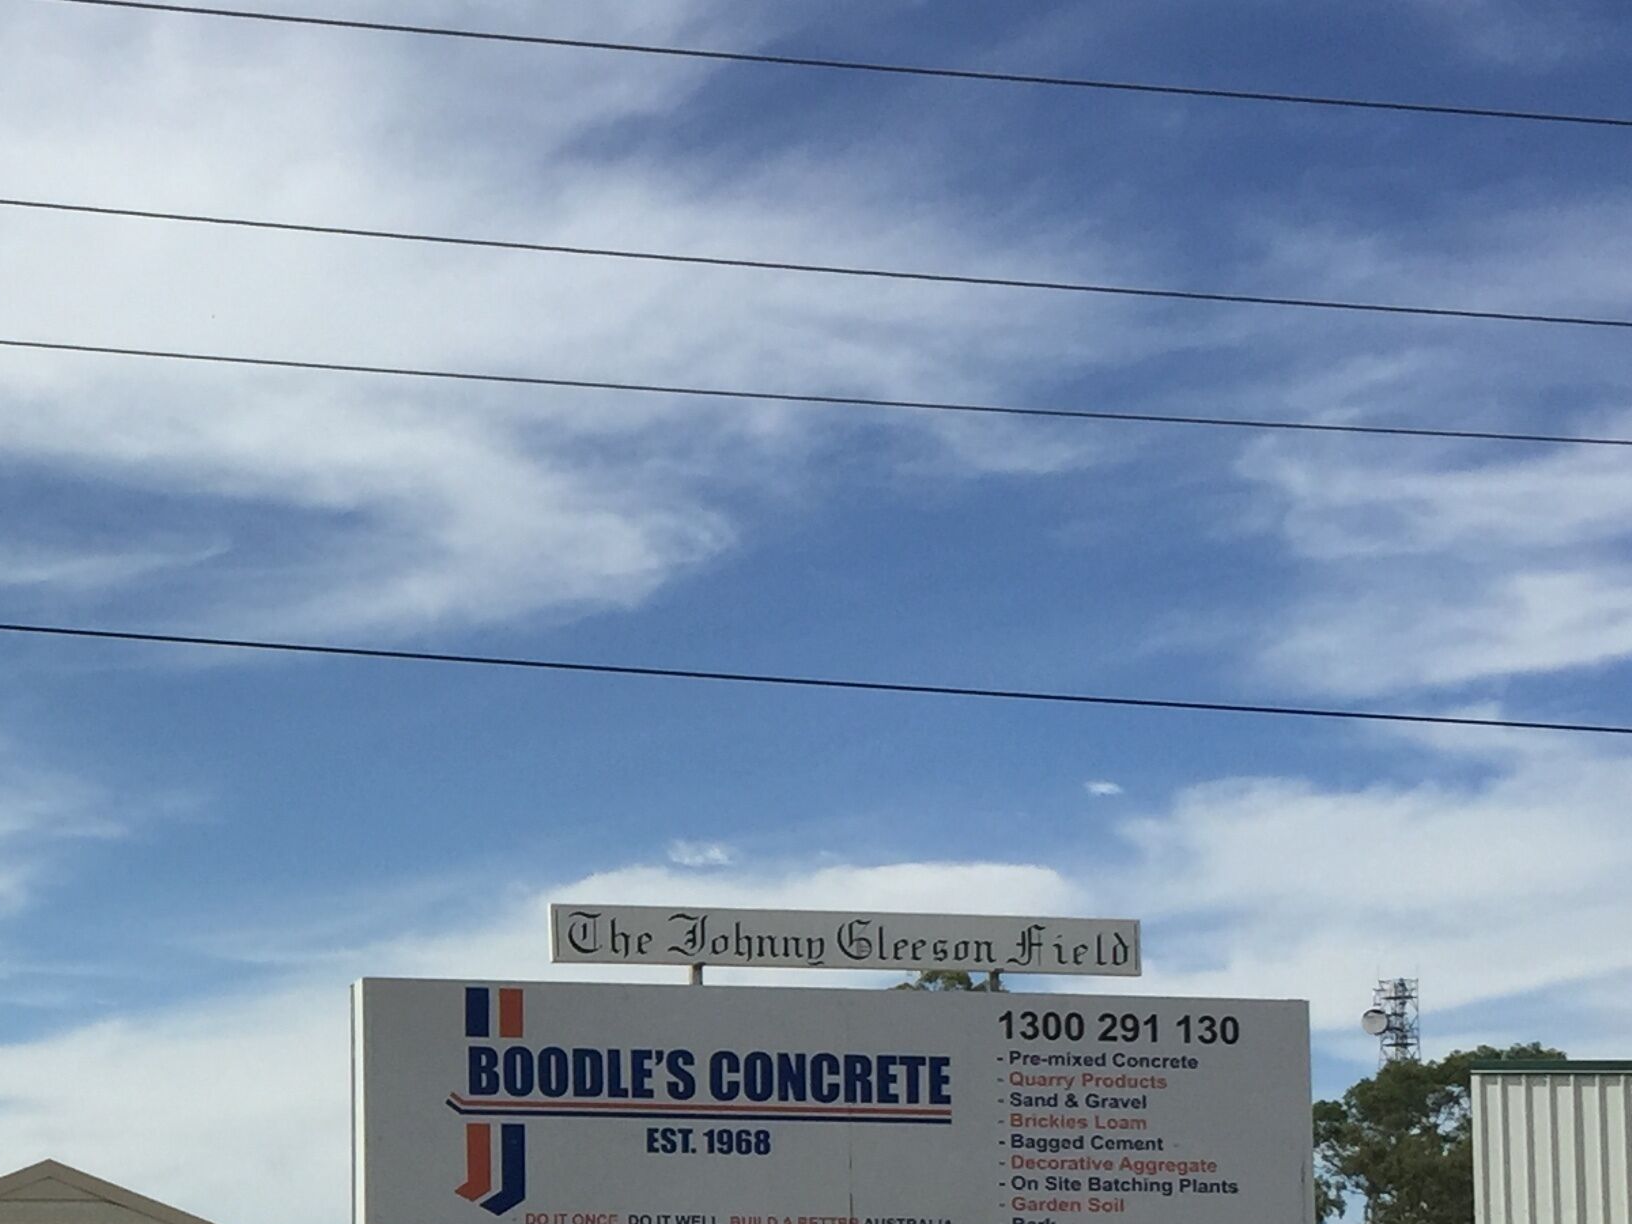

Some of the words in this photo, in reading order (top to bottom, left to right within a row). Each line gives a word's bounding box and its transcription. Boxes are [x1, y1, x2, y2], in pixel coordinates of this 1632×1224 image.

[568, 911, 653, 958] The
[667, 913, 826, 965] Johnny
[836, 919, 994, 965] Gleeson
[1006, 923, 1131, 967] Field
[998, 1010, 1085, 1041] 1300
[1097, 1013, 1159, 1043] 291
[1175, 1015, 1240, 1045] 130
[1112, 1053, 1199, 1069] Concrete
[708, 1050, 952, 1105] CONCRETE
[1009, 1071, 1075, 1091] Quarry
[1081, 1072, 1168, 1089] Products
[1009, 1092, 1058, 1108] Sand
[1064, 1093, 1079, 1108] &
[1085, 1094, 1148, 1109] Gravel
[1010, 1113, 1088, 1129] Brickies
[1094, 1115, 1147, 1130] Loam
[646, 1128, 697, 1154] EST.
[704, 1129, 772, 1155] 1968
[1010, 1133, 1084, 1152] Bagged
[1090, 1135, 1164, 1151] Cement
[1011, 1154, 1114, 1171] Decorative
[1119, 1156, 1218, 1176] Aggregate
[1011, 1176, 1038, 1191] On
[1045, 1176, 1081, 1192] Site
[1088, 1177, 1173, 1196] Batching
[1179, 1178, 1239, 1194] Plants
[1012, 1197, 1081, 1212] Garden
[1088, 1198, 1125, 1213] Soil
